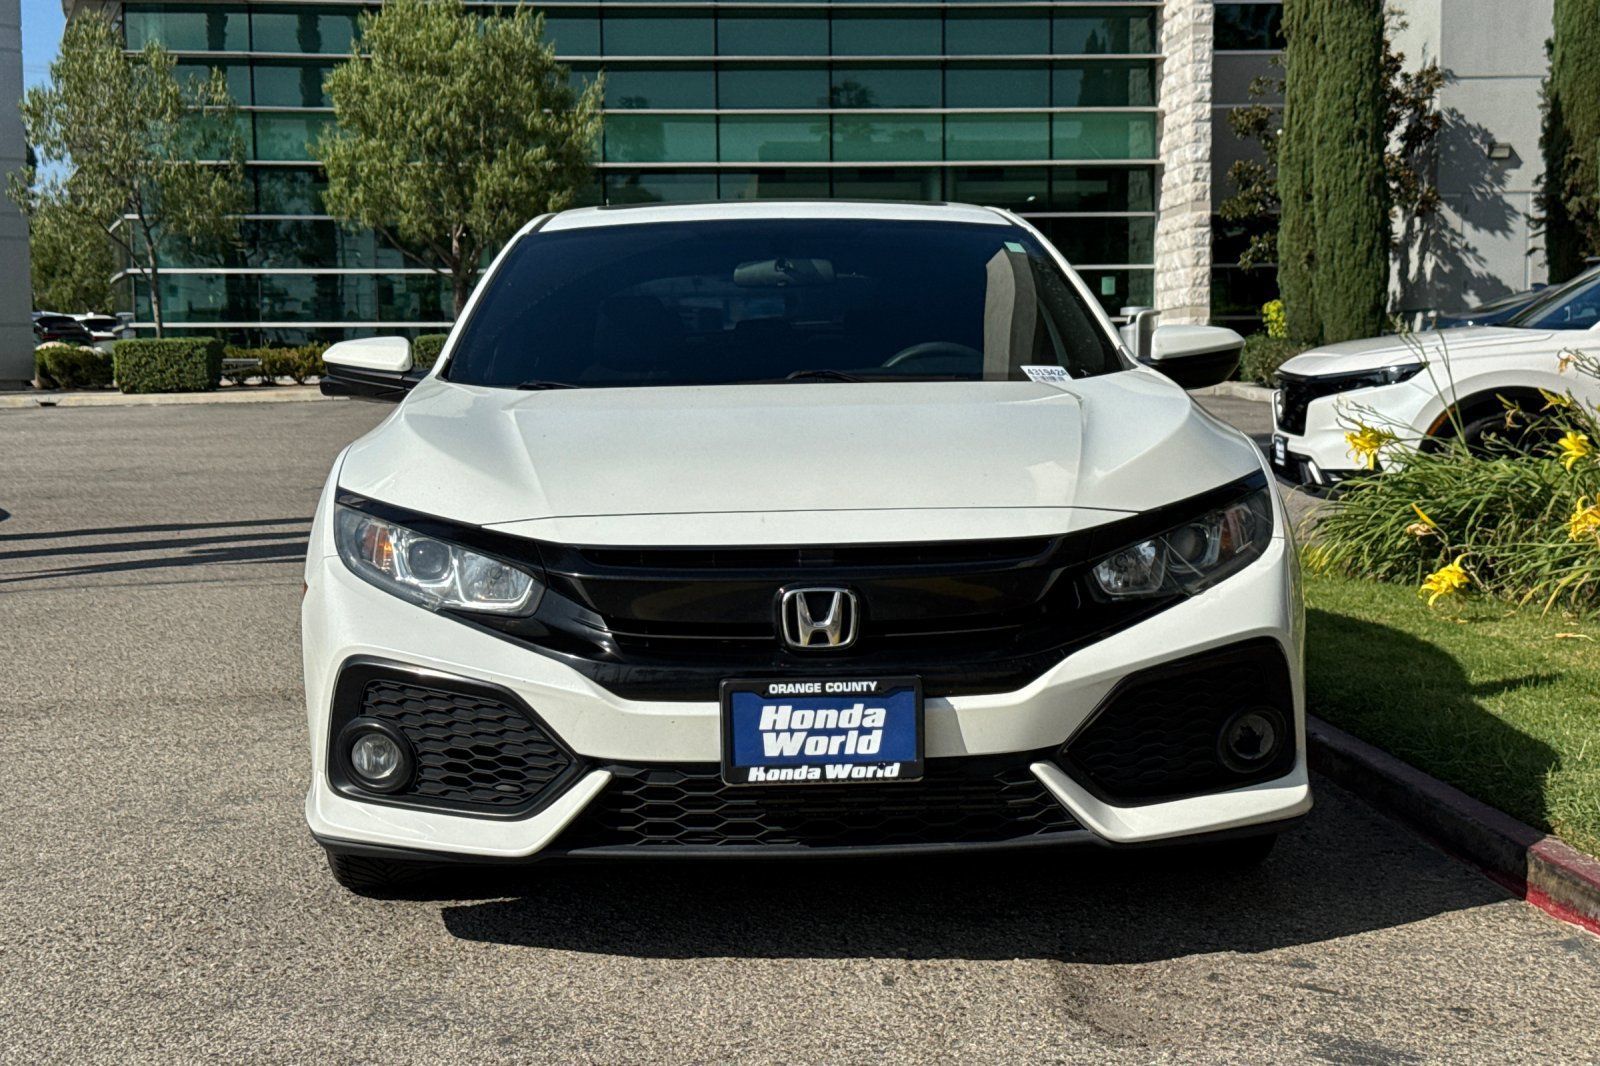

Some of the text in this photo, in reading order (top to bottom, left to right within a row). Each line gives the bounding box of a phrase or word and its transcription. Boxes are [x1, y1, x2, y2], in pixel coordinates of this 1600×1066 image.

[768, 680, 878, 695] ORANGE COUNTY
[758, 703, 887, 731] Honda
[762, 729, 883, 757] World
[748, 762, 901, 782] Honda World
